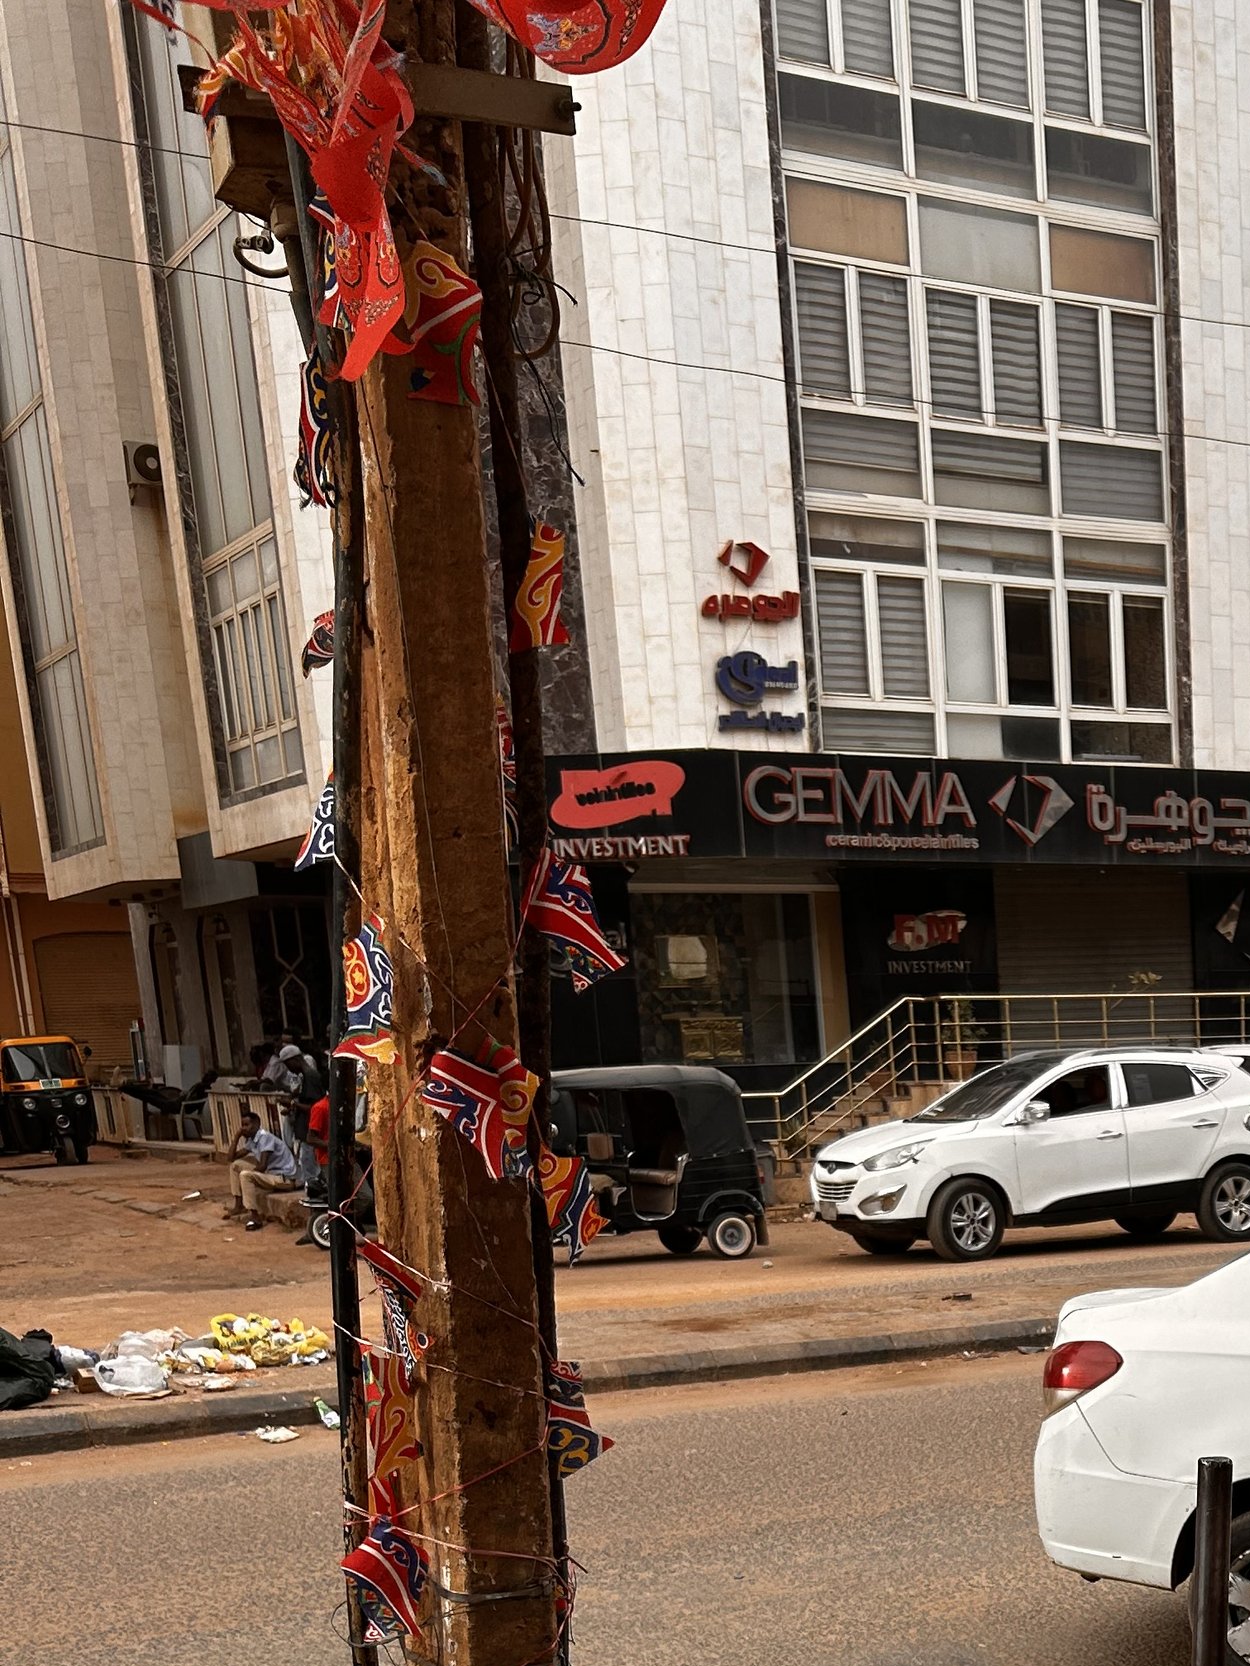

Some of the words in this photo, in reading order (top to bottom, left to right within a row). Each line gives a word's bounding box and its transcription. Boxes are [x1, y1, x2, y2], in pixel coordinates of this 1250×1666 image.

[744, 765, 977, 828] GEMMA
[552, 834, 691, 858] INVESTMENT
[887, 960, 972, 974] INVESTMENT
